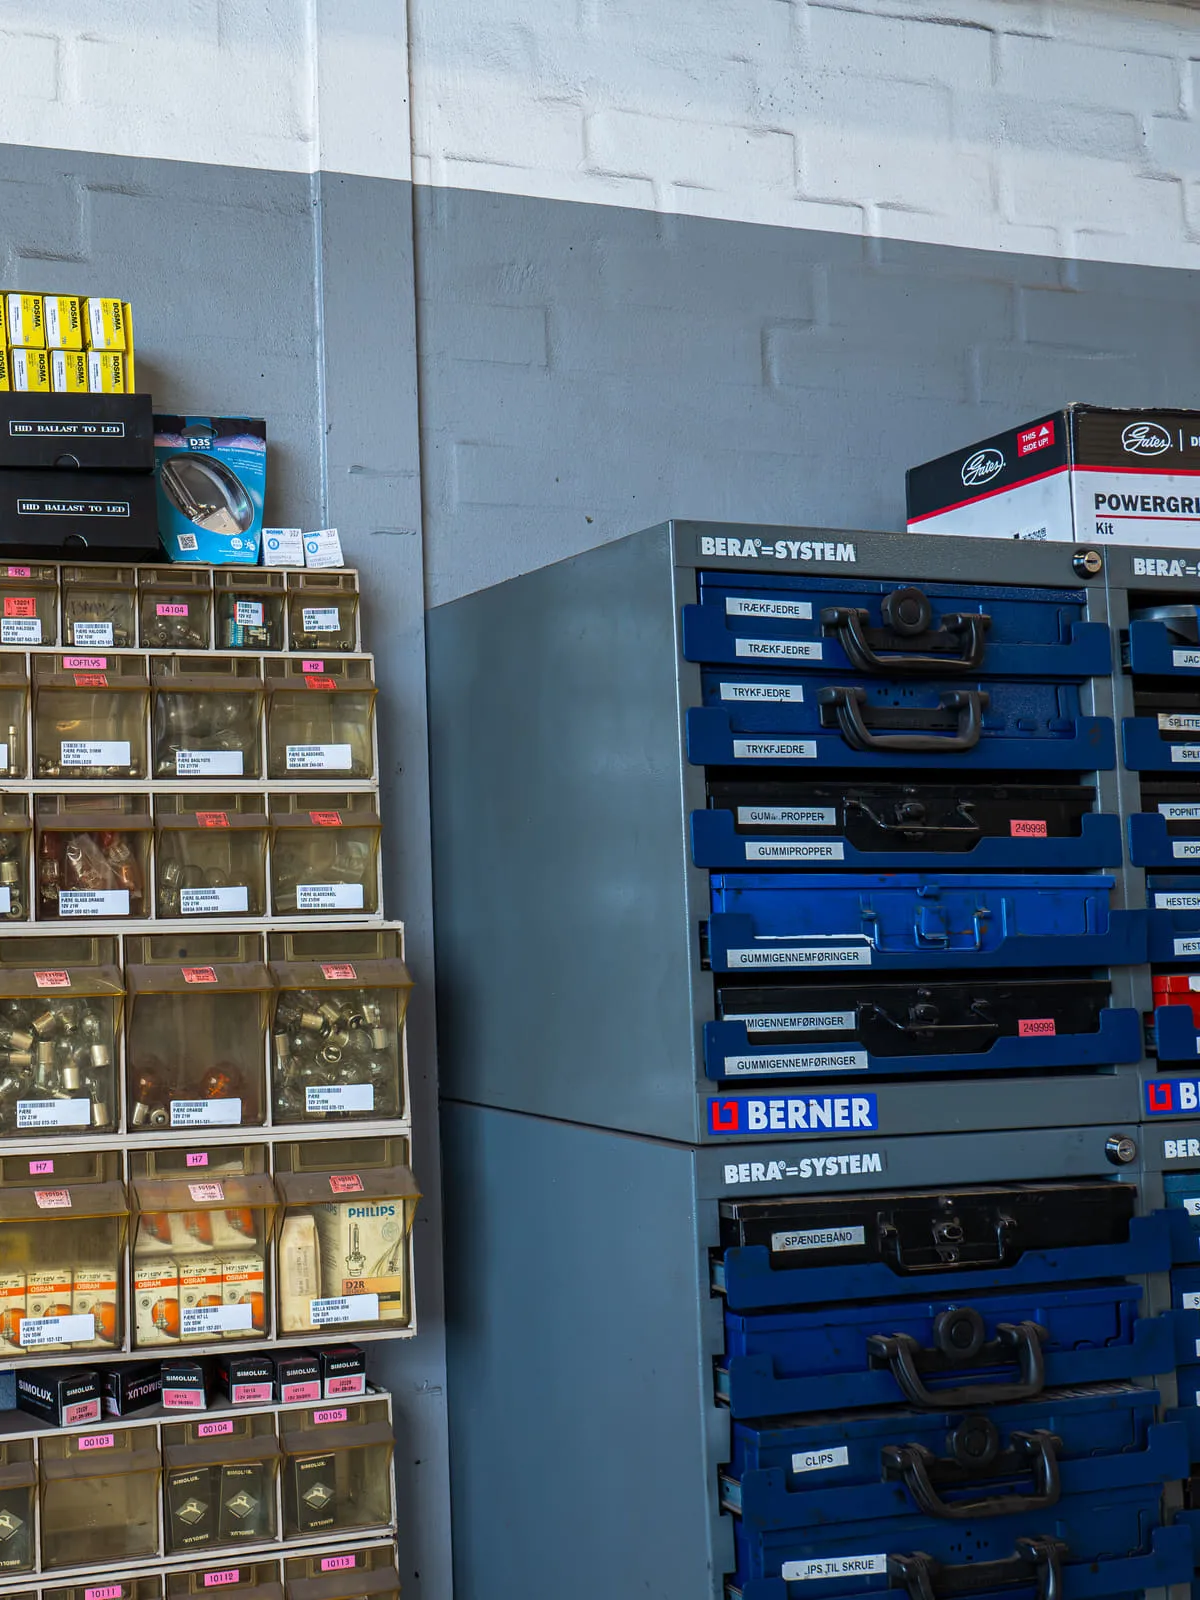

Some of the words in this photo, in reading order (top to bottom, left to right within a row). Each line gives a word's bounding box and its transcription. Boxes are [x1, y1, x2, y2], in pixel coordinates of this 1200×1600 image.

[33, 299, 41, 328] BOSMA
[69, 301, 78, 329] BOSMA
[113, 303, 121, 331] BOSMA
[77, 356, 85, 384] BOSMA
[38, 425, 78, 433] BALLAST
[190, 438, 210, 446] D3S
[1022, 432, 1036, 442] THIS
[1023, 442, 1037, 452] SIDE
[1038, 438, 1048, 448] UP!
[1096, 522, 1114, 535] Kit
[738, 602, 800, 616] TRÆKFJEDRE
[748, 643, 811, 656] TRÆKFJEDRE
[732, 686, 791, 699] TRYKFJEDRE
[746, 743, 805, 756] TRYKFJEDRE
[1015, 822, 1046, 835] 249998
[758, 847, 832, 856] GUMMIPROPPER
[741, 952, 859, 963] GUMMIGENNEMFØRINGER
[747, 1017, 844, 1027] MIGENNEMFØRINGER
[1023, 1021, 1055, 1034] 249999
[737, 1056, 856, 1069] GUMMIGENNEMFØRINGER
[747, 1099, 872, 1130] BERNER
[192, 1155, 203, 1163] H7
[36, 1163, 47, 1171] H7
[348, 1206, 395, 1218] PHILIPS
[785, 1232, 853, 1246] SPÆNDEBÅND
[345, 1281, 365, 1289] D2R
[318, 1412, 342, 1421] 00105
[203, 1424, 227, 1434] 00104
[84, 1438, 110, 1446] 00103
[805, 1454, 833, 1466] CLIPS
[326, 1560, 350, 1568] 10113
[842, 1560, 874, 1571] SKRUE
[209, 1574, 233, 1583] 10112
[91, 1589, 116, 1598] 10111
